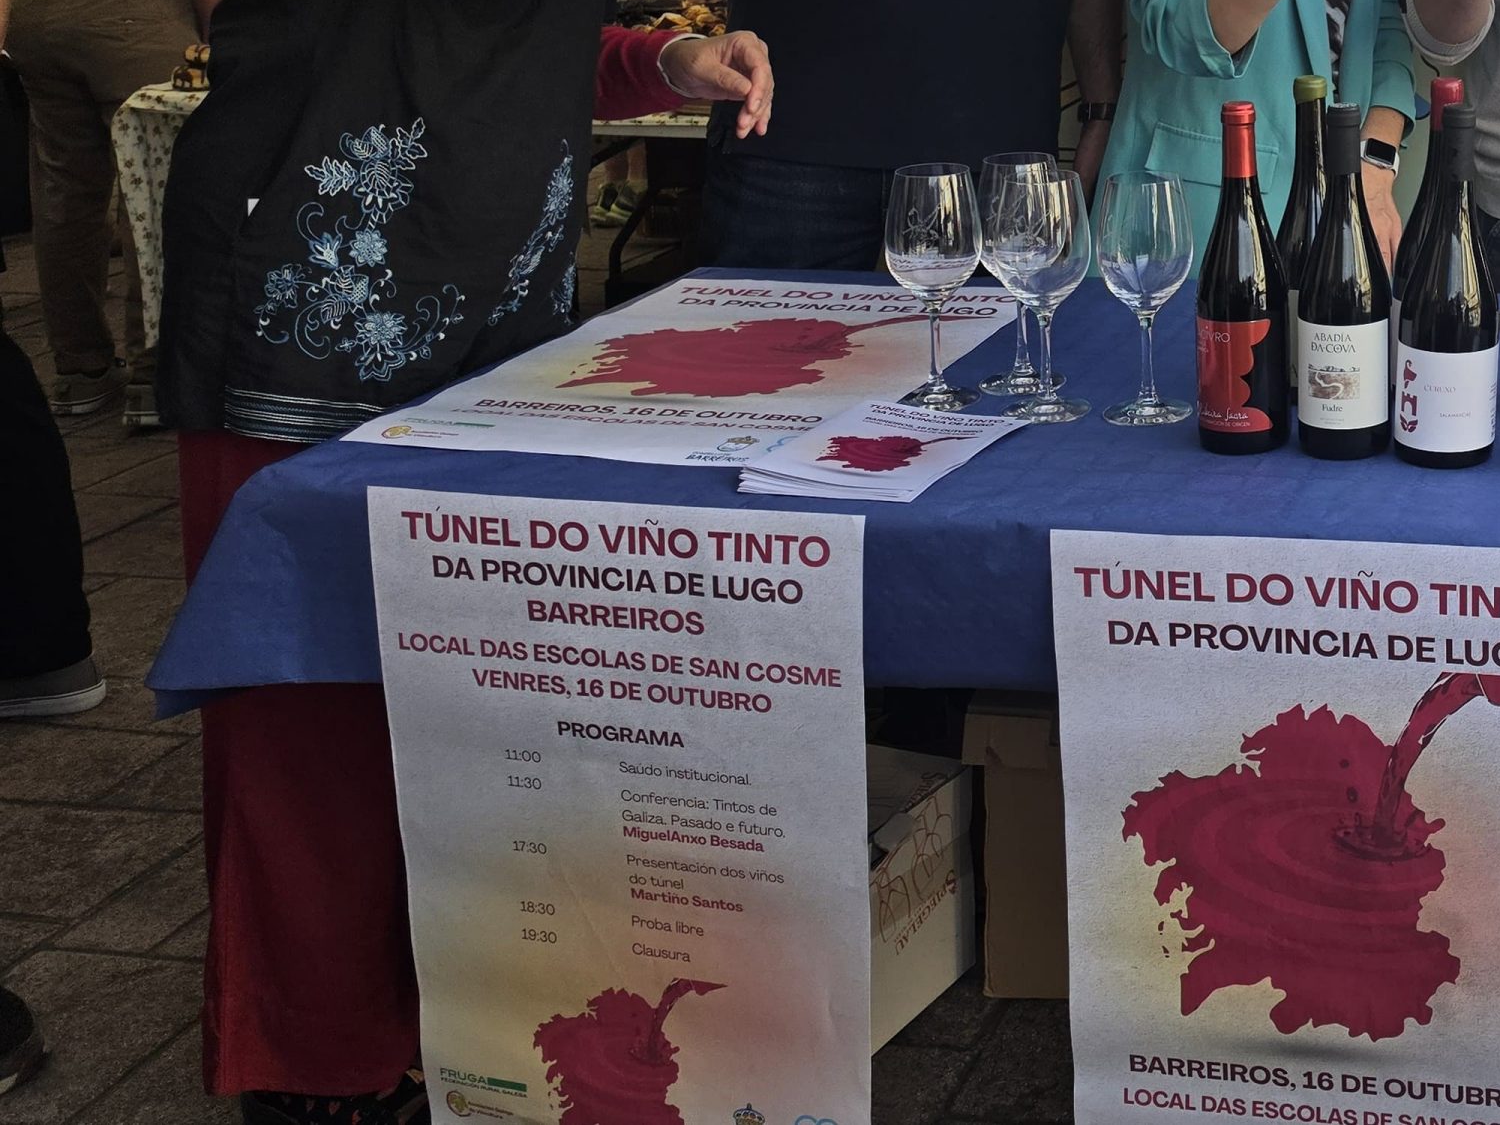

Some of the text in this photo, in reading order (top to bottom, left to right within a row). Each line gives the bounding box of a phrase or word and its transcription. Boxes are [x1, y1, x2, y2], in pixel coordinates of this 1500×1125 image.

[682, 286, 774, 297] TÚNEL
[781, 290, 833, 300] DO
[721, 300, 872, 312] PROVINCIA
[878, 304, 918, 314] DE
[623, 407, 656, 416] 16
[657, 408, 694, 417] DE
[696, 410, 823, 423] OUTUBRO
[400, 506, 830, 567] TÚNEL DO VIÑO TINTO
[432, 555, 803, 605] DA PROVINCIA DE LUGO
[1073, 561, 1215, 603] TÚNEL
[1226, 572, 1294, 606] DO
[1304, 570, 1419, 615] VIÑO
[527, 600, 705, 635] BARREIROS
[1107, 620, 1159, 647] DA
[1169, 622, 1379, 660] PROVINCIA
[1387, 635, 1436, 663] DE
[398, 632, 842, 688] LOCAL DAS ESCOLAS DE SAN COSME
[472, 668, 772, 713] VENRES, 16 DE OUTUBRO
[557, 720, 684, 748] PROGRAMA
[504, 748, 542, 764] 11:00
[507, 775, 542, 790] 11:30
[619, 760, 752, 786] Saúdo institucional.
[620, 789, 777, 817] Conferencia: Tintos de
[621, 809, 786, 838] Galiza. Pasado e futuro.
[512, 840, 547, 855] 17:30
[622, 826, 764, 853] MiguelAnxo Besada
[626, 854, 784, 884] Presentación dos viños
[628, 873, 684, 890] do túnel
[519, 900, 555, 916] 18:30
[630, 888, 743, 913] Martiño Santos
[521, 927, 557, 945] 19:30
[631, 916, 704, 937] Proba libre
[632, 943, 691, 963] Clausura
[440, 1068, 488, 1085] FRUGA
[1129, 1054, 1296, 1092] BARREIROS,
[1302, 1071, 1335, 1092] 16
[1341, 1074, 1378, 1095] DE
[1123, 1087, 1196, 1111] LOCAL
[1201, 1095, 1247, 1116] DAS
[1251, 1100, 1358, 1125] ESCOLAS
[1362, 1110, 1393, 1125] DE
